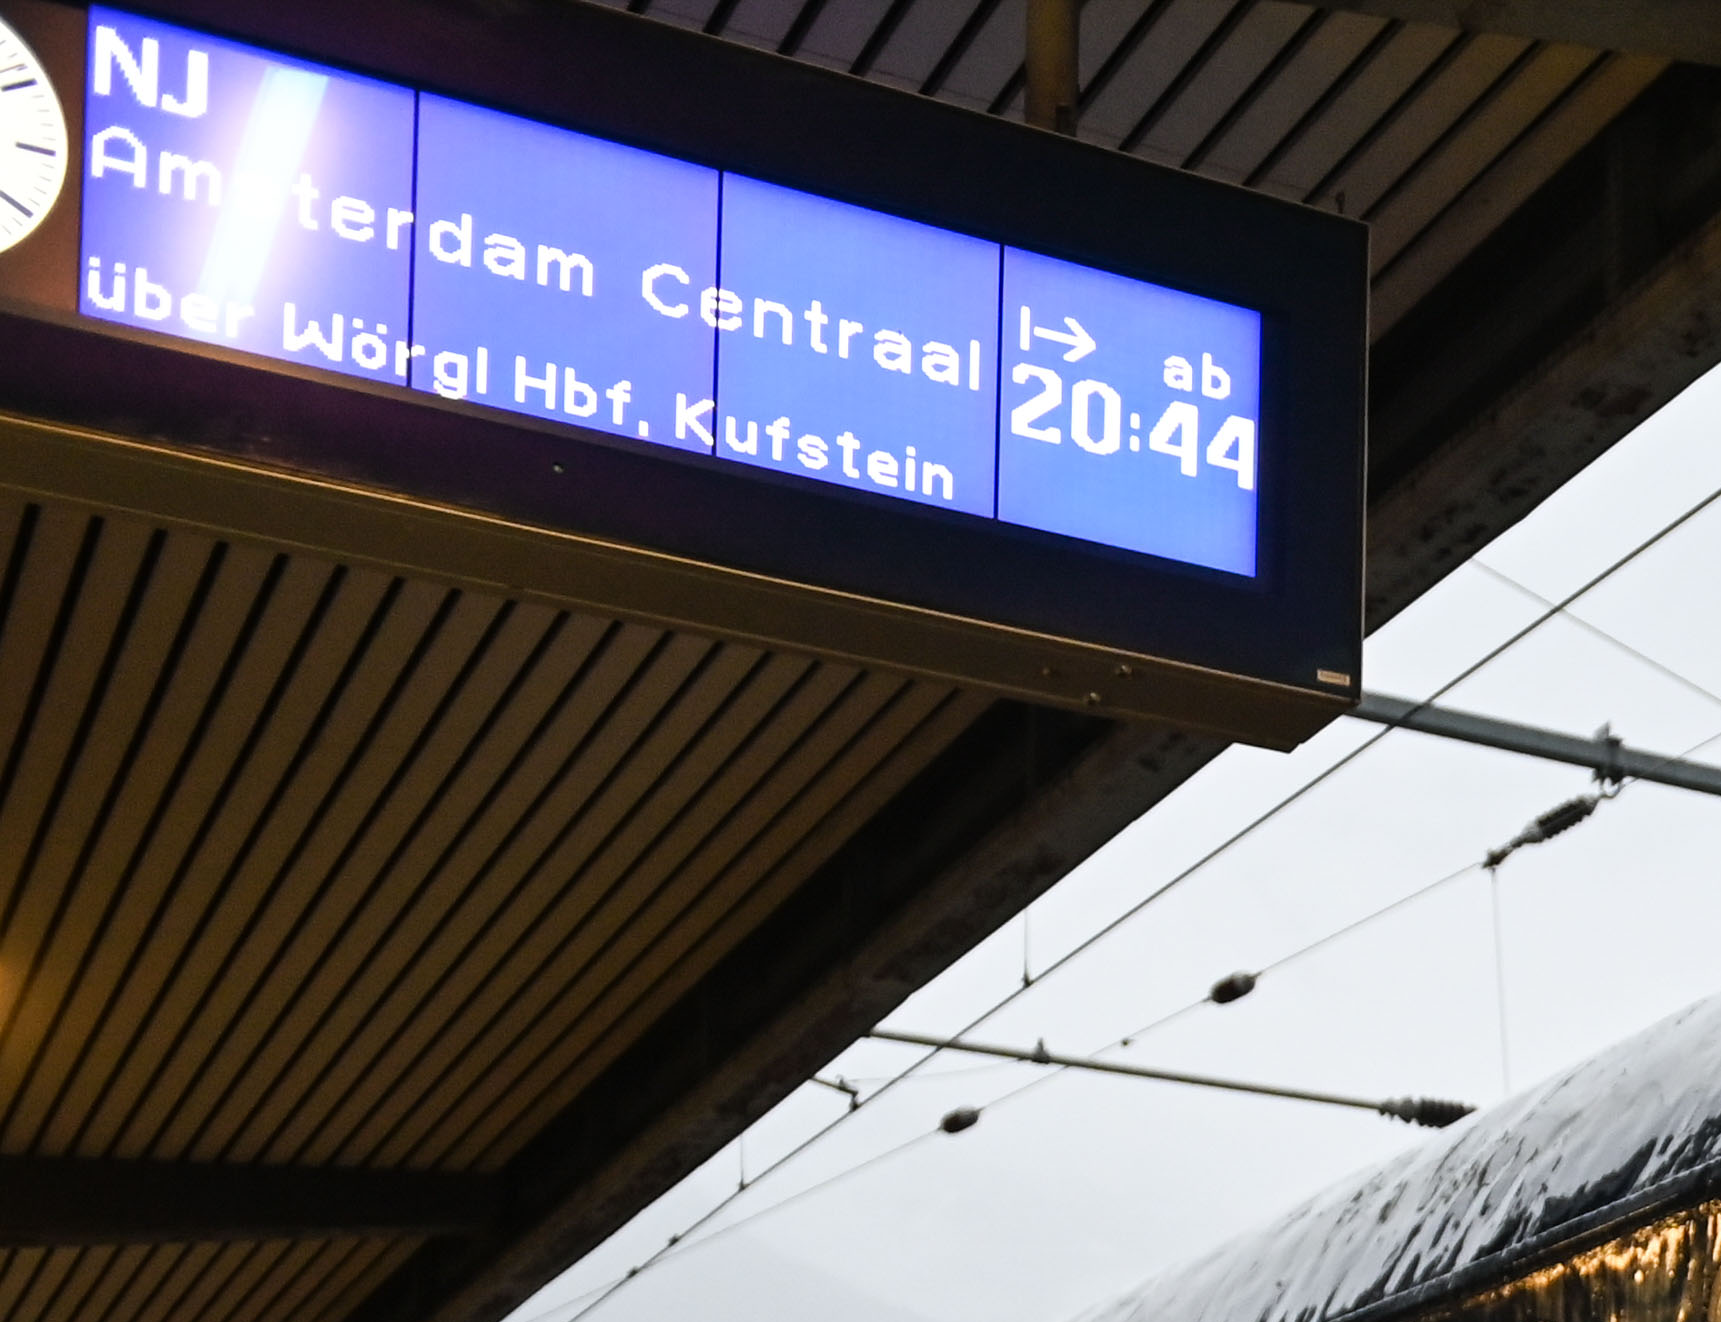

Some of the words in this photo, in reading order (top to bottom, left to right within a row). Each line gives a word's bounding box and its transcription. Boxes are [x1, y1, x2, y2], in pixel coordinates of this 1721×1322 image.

[93, 24, 209, 118] NJ
[91, 125, 595, 298] Amterdam
[642, 262, 981, 391] Centraal
[87, 256, 255, 339] über
[283, 301, 489, 399] Wörgl
[674, 398, 955, 500] Kufstein
[1011, 366, 1255, 491] 20:44
[1162, 350, 1232, 398] ab
